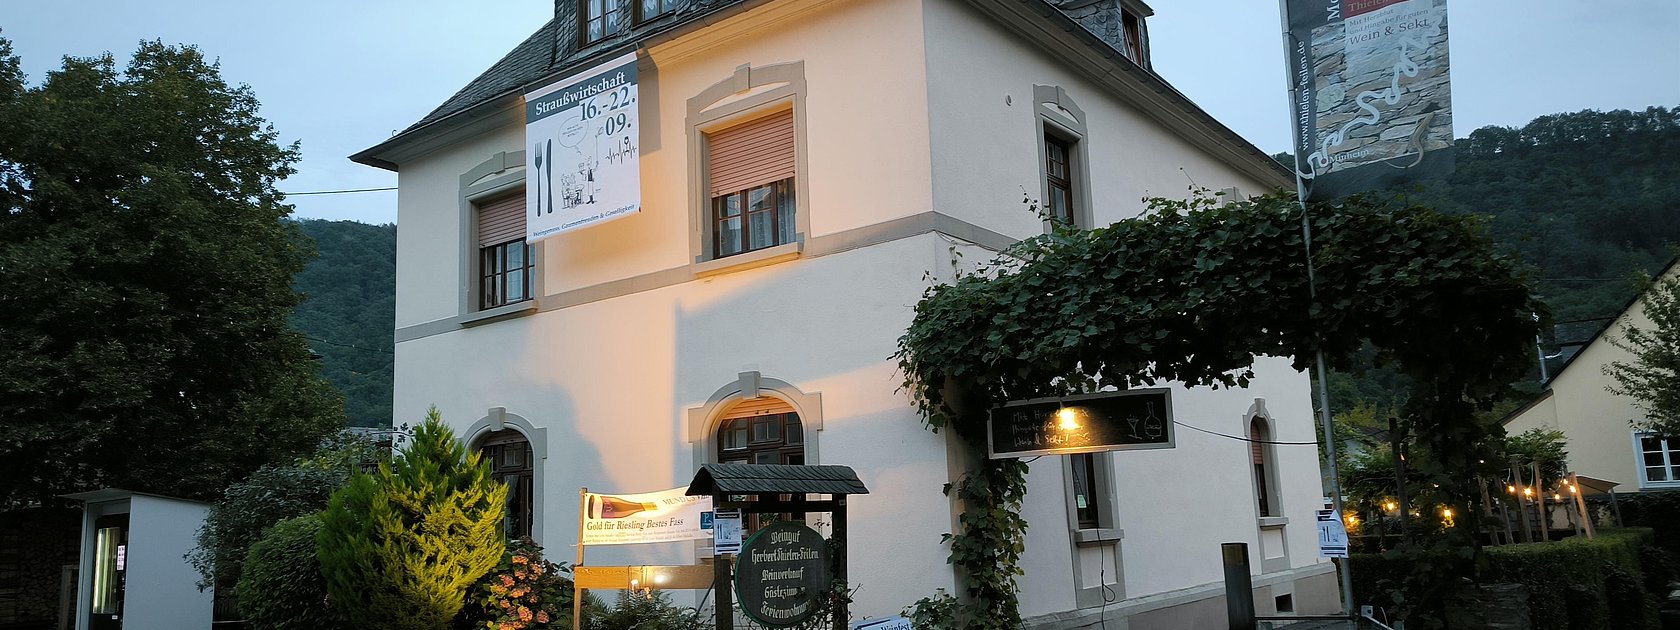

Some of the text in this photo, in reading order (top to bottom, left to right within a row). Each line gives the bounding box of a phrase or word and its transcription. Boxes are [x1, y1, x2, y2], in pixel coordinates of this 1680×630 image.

[1364, 9, 1394, 22] Herzblut
[1365, 17, 1395, 29] Hingabe
[1407, 9, 1429, 19] guten
[1350, 19, 1429, 45] Wein & Sekt
[536, 72, 626, 116] Straußwirtschaft
[1297, 41, 1310, 151] www.thielen-feilen.de
[580, 86, 635, 121] 16.-22.
[605, 113, 631, 136] 09.
[1329, 150, 1369, 163] Minheim
[586, 518, 684, 531] Gold für Riesling Bestes Fass
[771, 529, 800, 545] Weingut
[752, 548, 777, 565] Herbert
[761, 567, 804, 583] Weinverkauf
